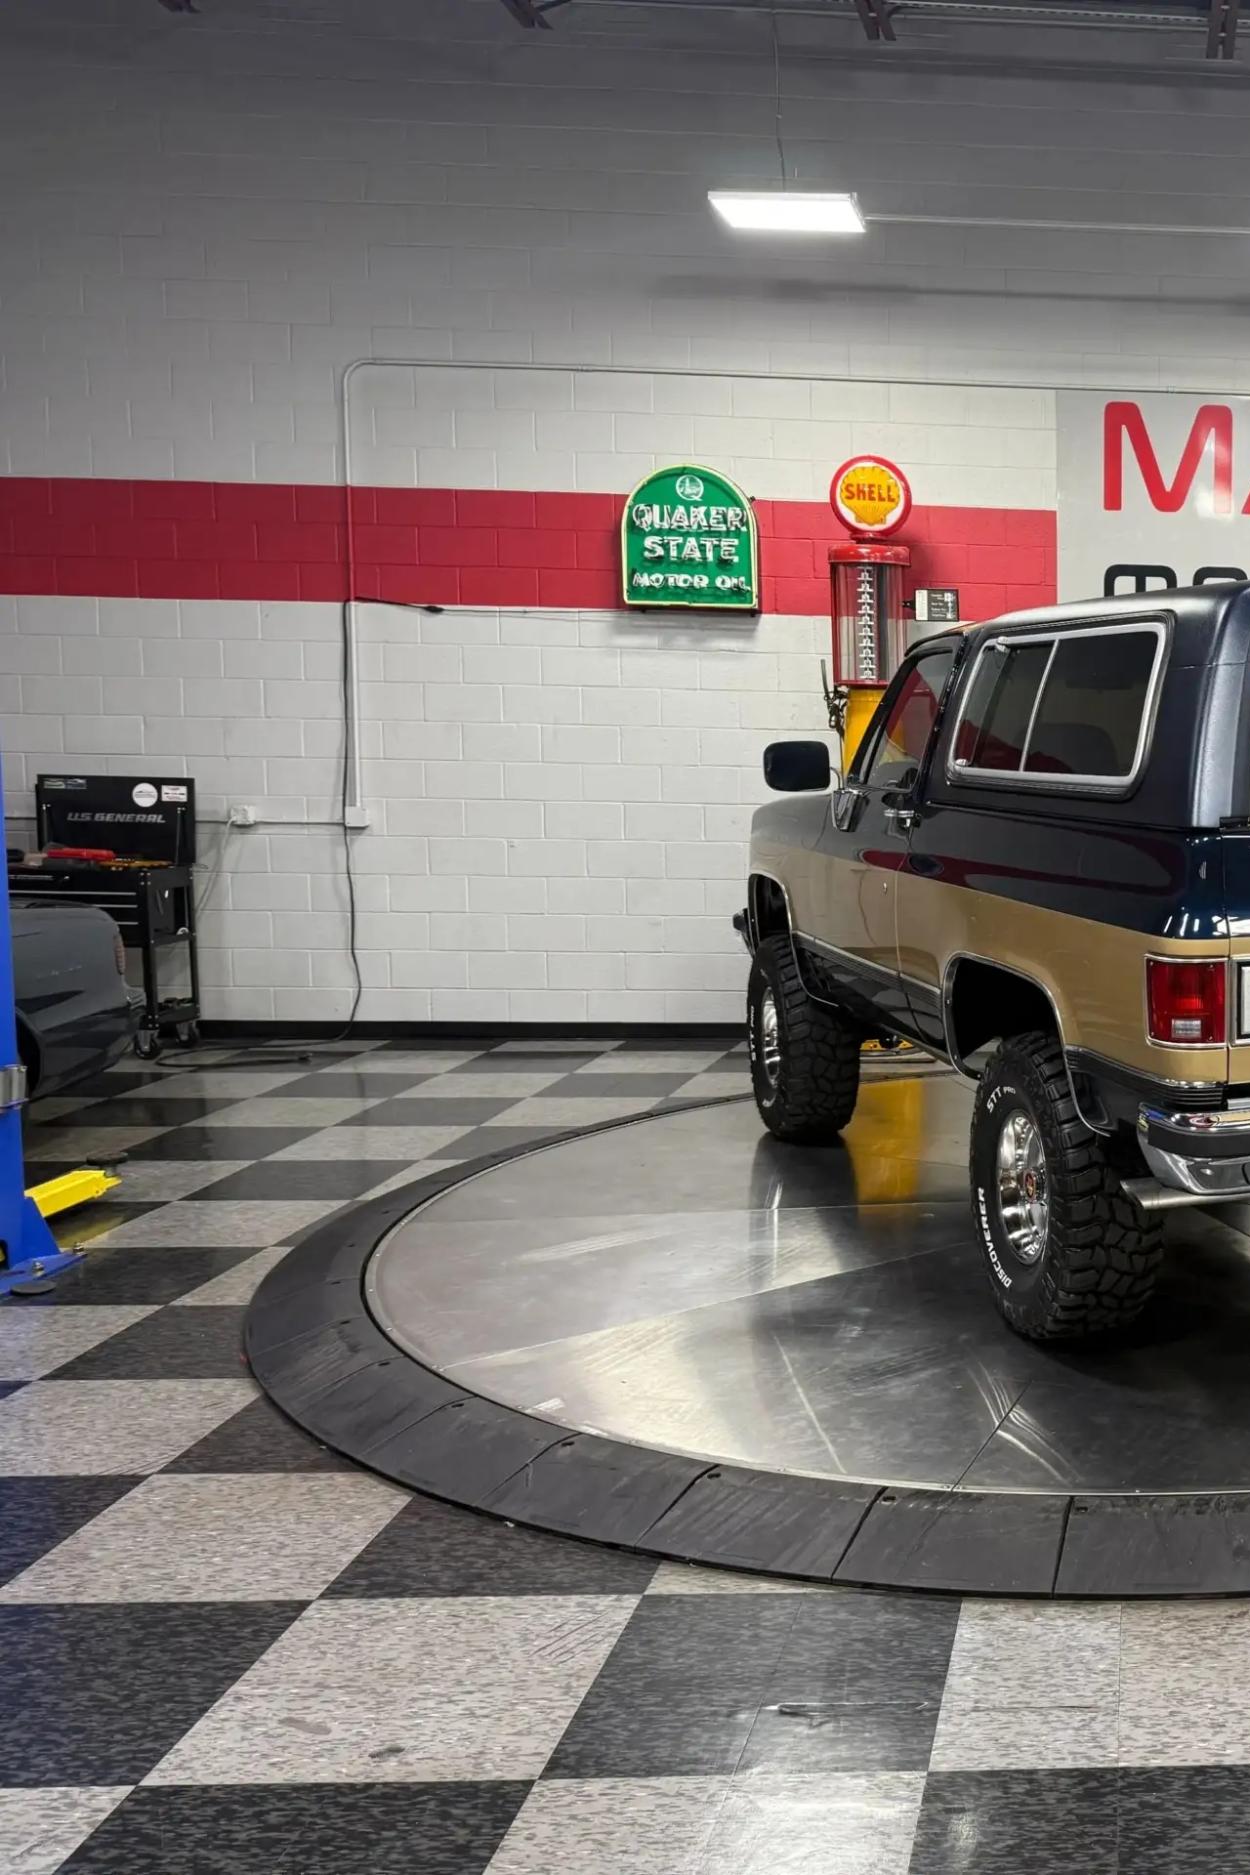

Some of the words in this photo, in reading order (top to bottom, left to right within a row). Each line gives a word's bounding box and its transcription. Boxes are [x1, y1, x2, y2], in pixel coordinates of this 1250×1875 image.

[844, 483, 896, 503] SHELL
[632, 503, 747, 531] QUAKER
[643, 536, 739, 562] STATE
[633, 573, 709, 588] MOTOR
[715, 575, 752, 591] OIL
[94, 812, 166, 824] GENERAL
[986, 1086, 1002, 1113] STT
[978, 1187, 1012, 1288] DISCOVERER
